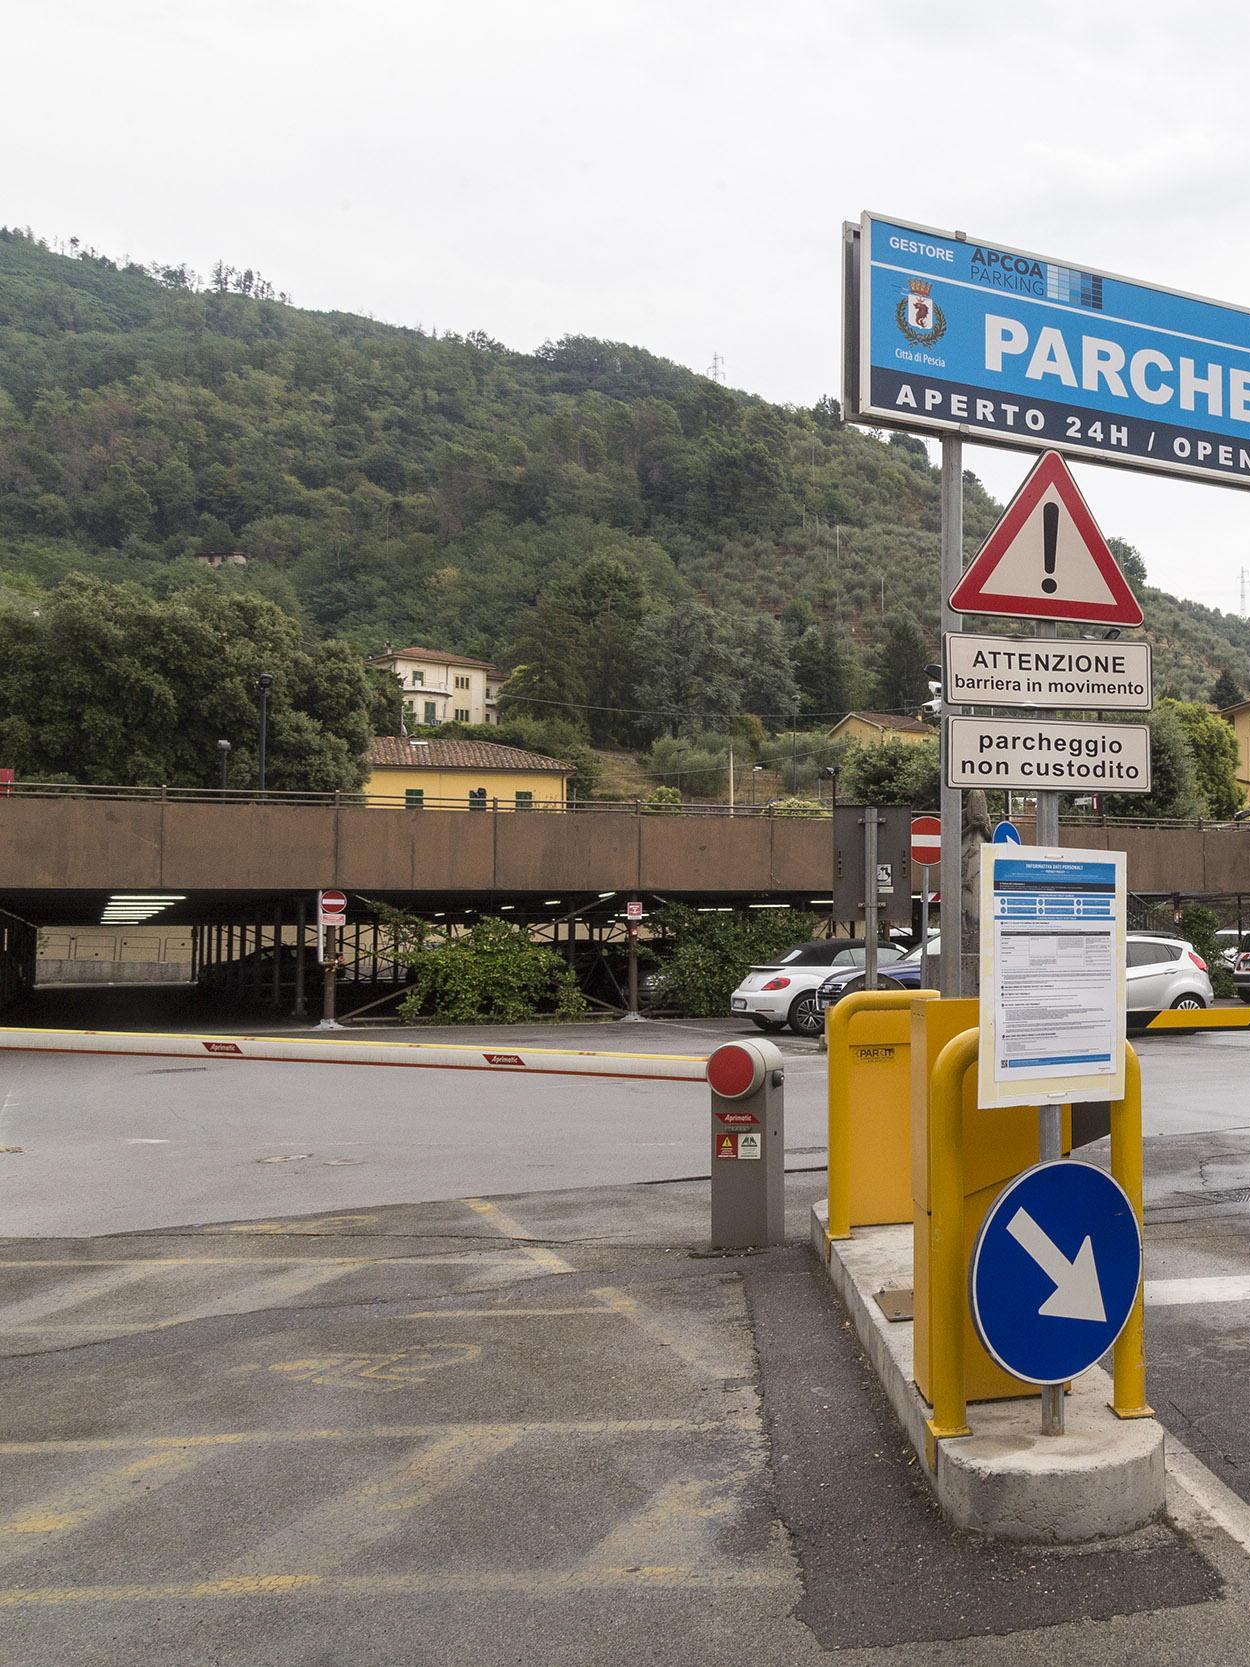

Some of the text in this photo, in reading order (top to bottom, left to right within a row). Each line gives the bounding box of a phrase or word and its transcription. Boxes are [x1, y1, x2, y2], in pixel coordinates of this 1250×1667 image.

[889, 236, 954, 263] GESTORE
[970, 247, 1044, 279] APCOA
[970, 266, 1045, 297] PARKING
[895, 348, 946, 368] Città di Pescia
[896, 384, 1046, 432] APERTO
[1065, 416, 1129, 448] 24H
[1147, 431, 1156, 452] /
[972, 650, 1126, 674] ATTENZIONE
[955, 674, 1144, 695] barriera in movimento
[978, 732, 1123, 758] parcheggio
[961, 758, 1139, 779] non custodito
[724, 1113, 752, 1123] Aprimatic
